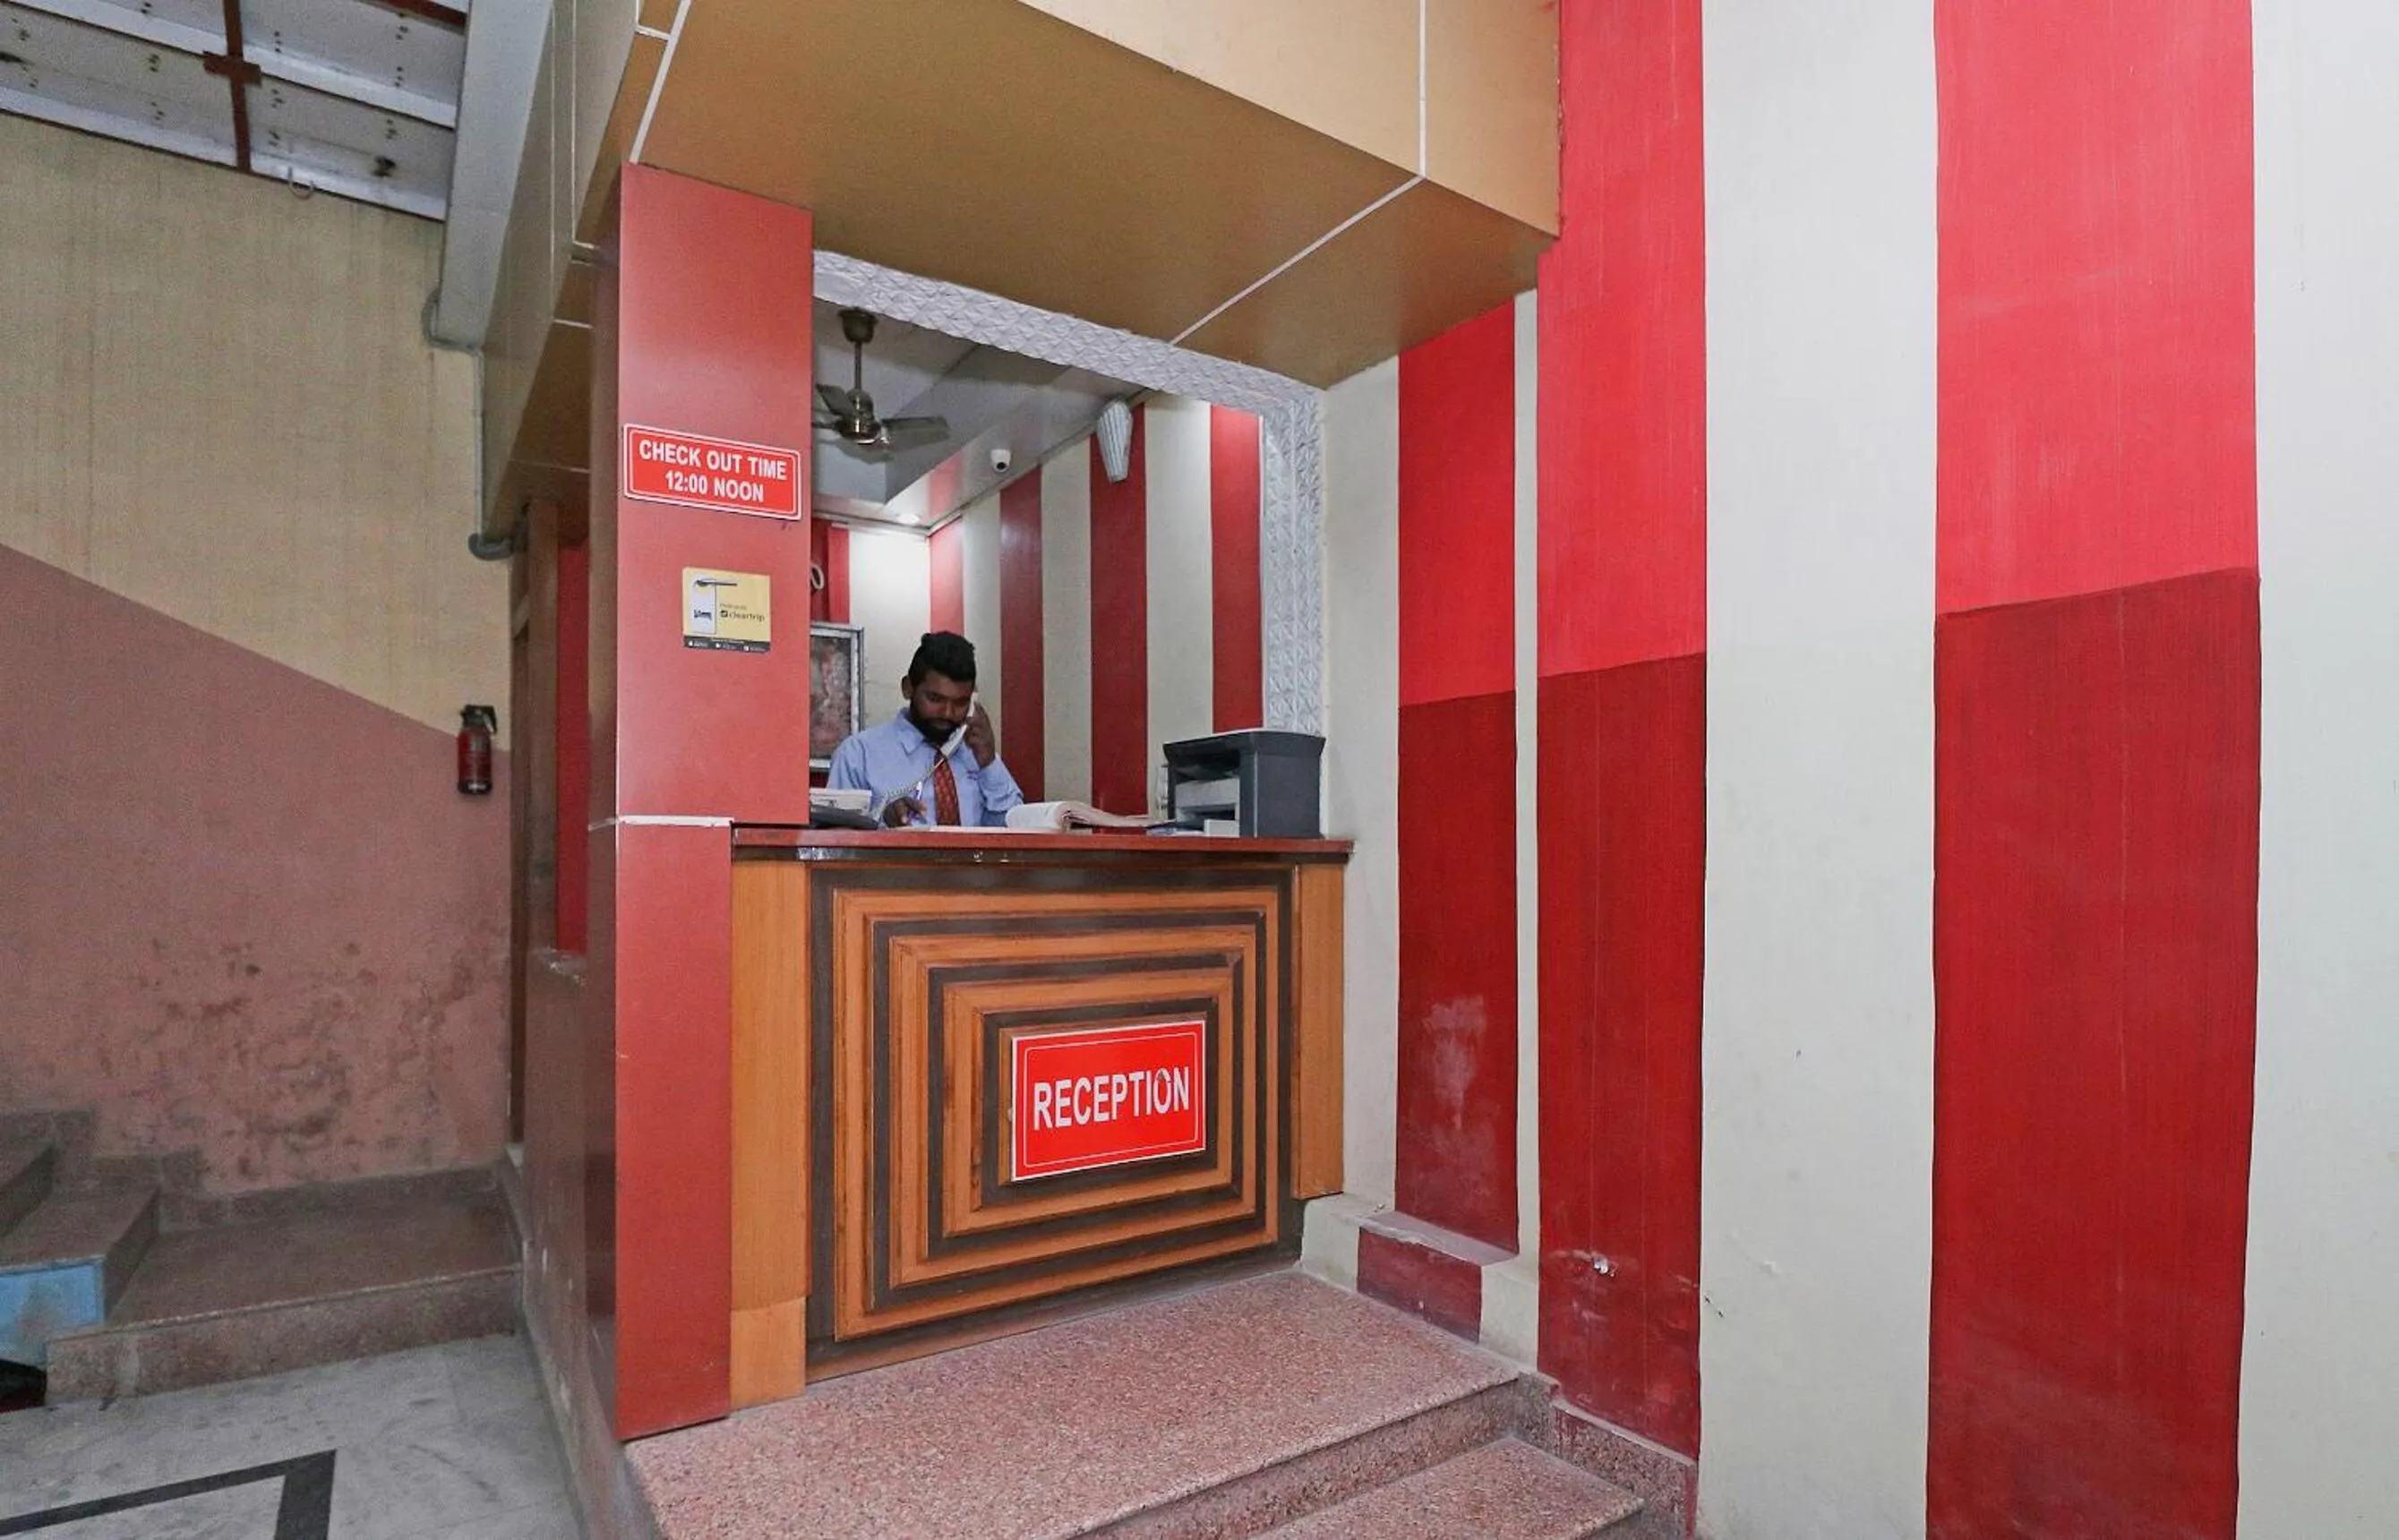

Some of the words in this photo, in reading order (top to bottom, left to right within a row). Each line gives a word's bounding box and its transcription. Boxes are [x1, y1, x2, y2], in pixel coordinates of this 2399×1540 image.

[638, 439, 701, 467] CHECK
[707, 450, 742, 474] OUT
[747, 456, 787, 481] TIME
[664, 470, 707, 494] 12:00
[714, 480, 764, 502] NOON
[728, 611, 766, 622] cleartrip
[1033, 1066, 1189, 1131] RECEPTION
